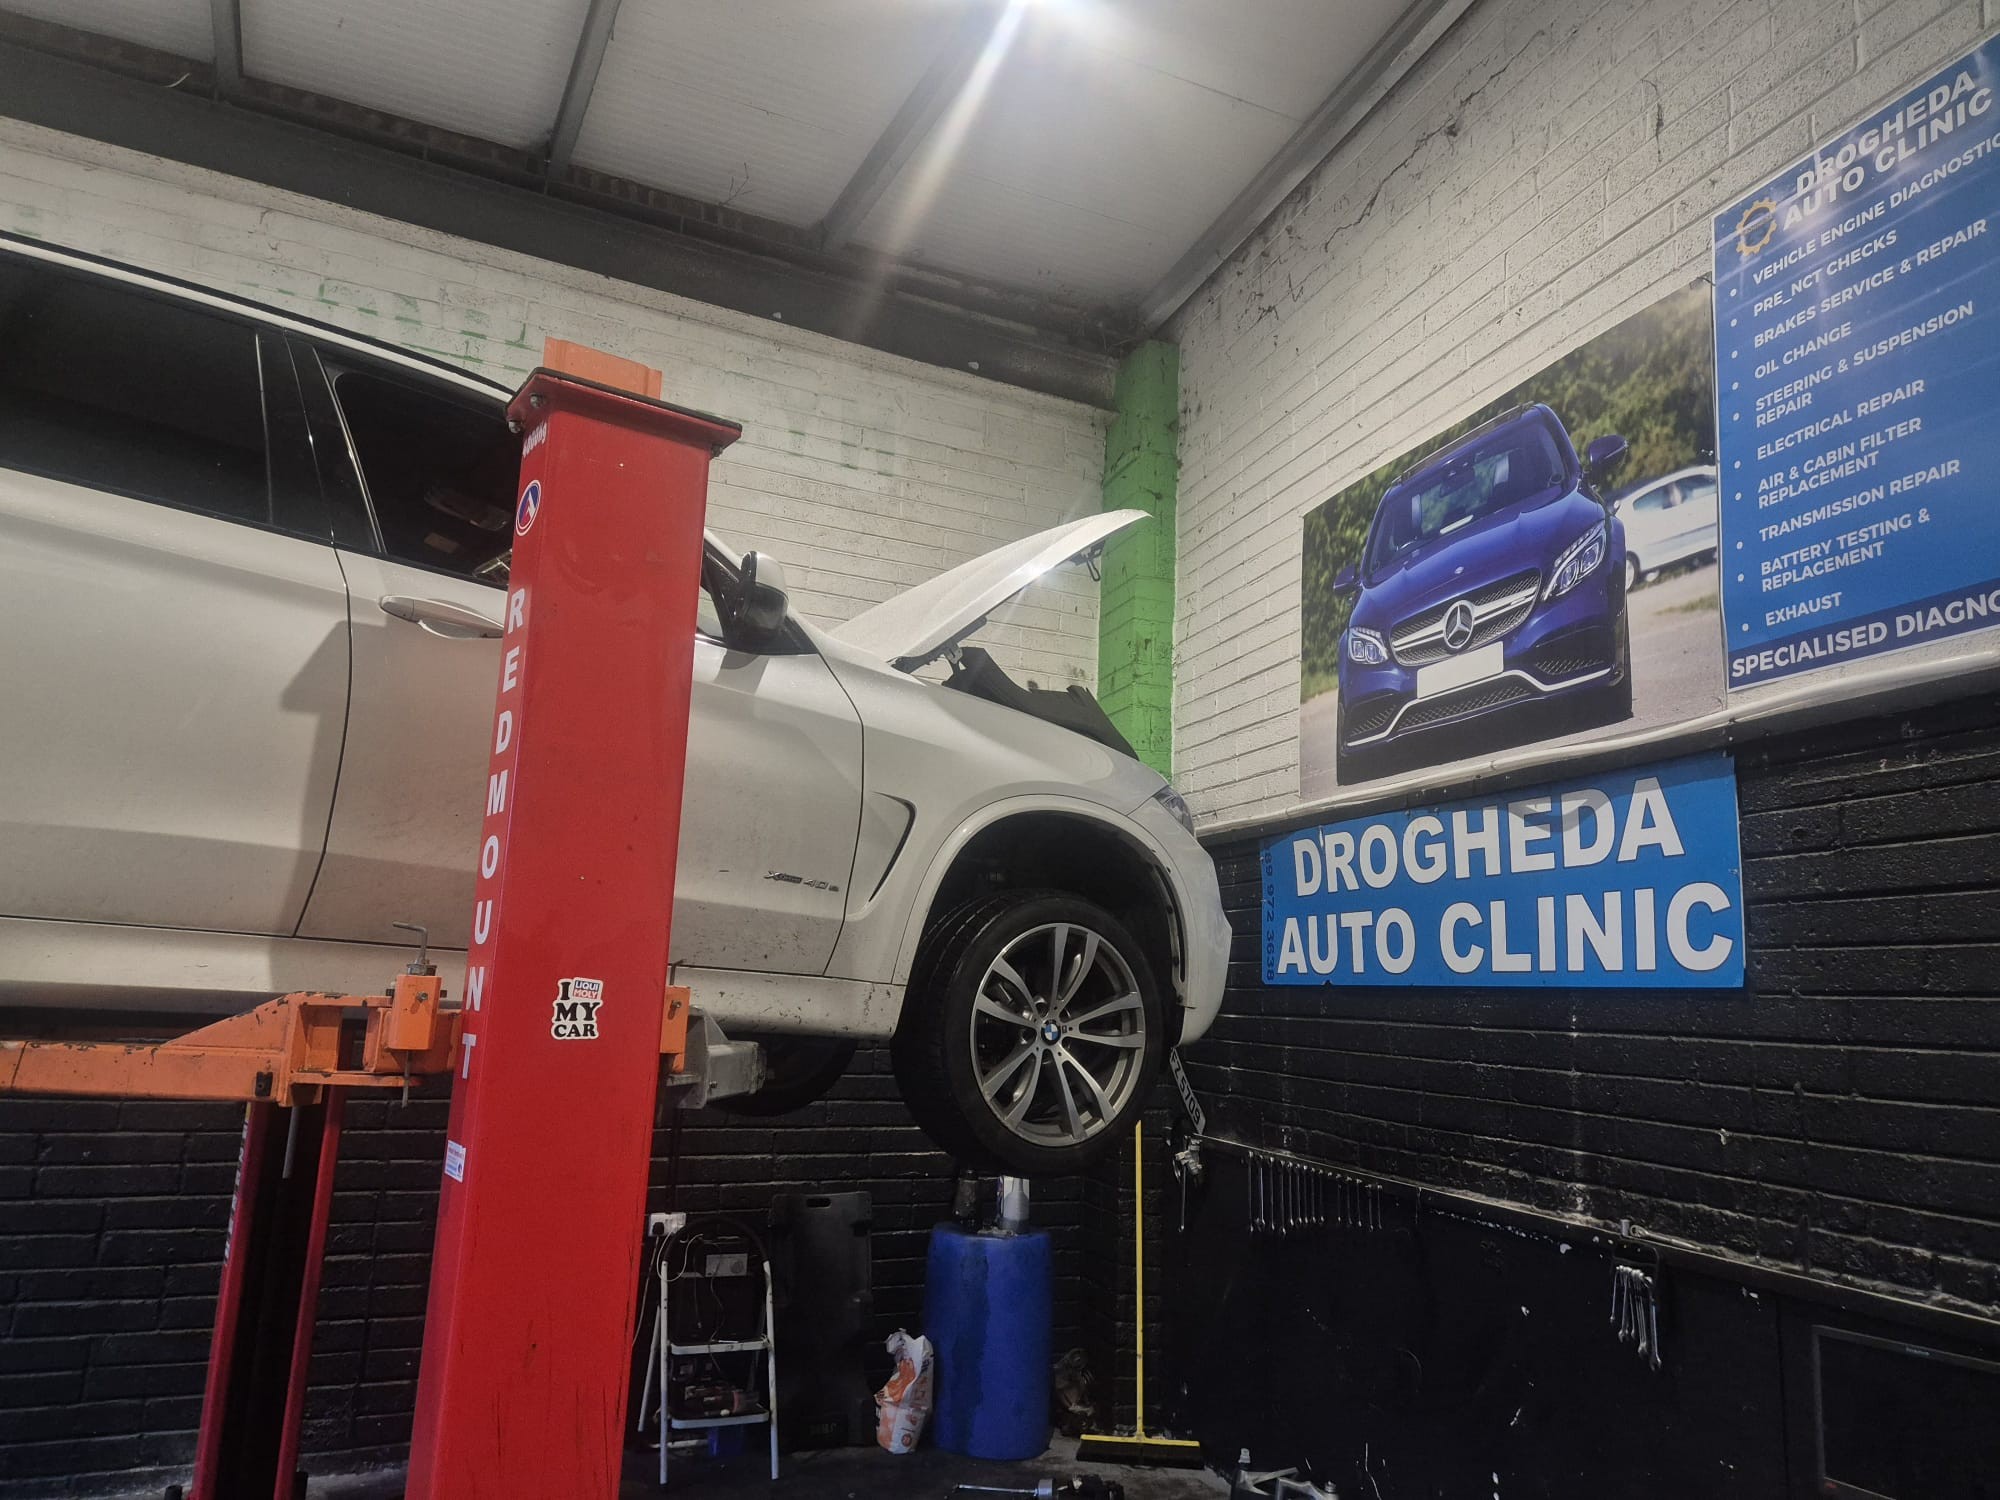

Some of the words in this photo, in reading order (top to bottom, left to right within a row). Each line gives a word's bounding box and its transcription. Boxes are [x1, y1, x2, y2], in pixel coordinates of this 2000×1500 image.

[1783, 166, 1865, 231] AUTO
[1875, 88, 1992, 173] CLINIC
[1796, 71, 1976, 196] DROGHEDA
[1753, 239, 1816, 285] VEHICLE
[1821, 201, 1885, 247] ENGINE
[1826, 230, 1897, 276] CHECKS
[1754, 306, 1816, 348] BRAKES
[1821, 266, 1895, 313] SERVICE
[1900, 258, 1912, 274] &
[1917, 218, 1987, 266] REPAIR
[1754, 360, 1779, 379] OIL
[1783, 321, 1852, 365] CHANGE
[1755, 365, 1833, 411] STEERING
[1837, 359, 1849, 373] &
[1853, 301, 1974, 366] SUSPENSION
[1756, 392, 1813, 428] REPAIR
[1757, 409, 1852, 460] ELECTRICAL
[1857, 379, 1925, 418] REPAIR
[1758, 474, 1785, 493] AIR
[1789, 466, 1799, 480] &
[1803, 442, 1855, 474] CABIN
[1860, 417, 1922, 452] FILTER
[1758, 451, 1879, 509] REPLACEMENT
[1759, 486, 1884, 542] TRANSMISSION
[1890, 459, 1960, 495] REPAIR
[1761, 539, 1831, 576] BATTERY
[1836, 513, 1912, 551] TESTING
[1918, 508, 1930, 523] &
[1762, 541, 1884, 592] REPLACEMENT
[1765, 592, 1842, 626] EXHAUST
[1732, 622, 1887, 677] SPECIALISED
[1293, 777, 1685, 896] DROGHEDA
[1277, 907, 1416, 975] AUTO
[1439, 882, 1733, 973] CLINIC
[555, 1002, 600, 1021] MY
[560, 982, 571, 1000] I
[575, 981, 599, 991] LIQUI
[574, 989, 598, 999] MOLY
[554, 1023, 596, 1037] CAR
